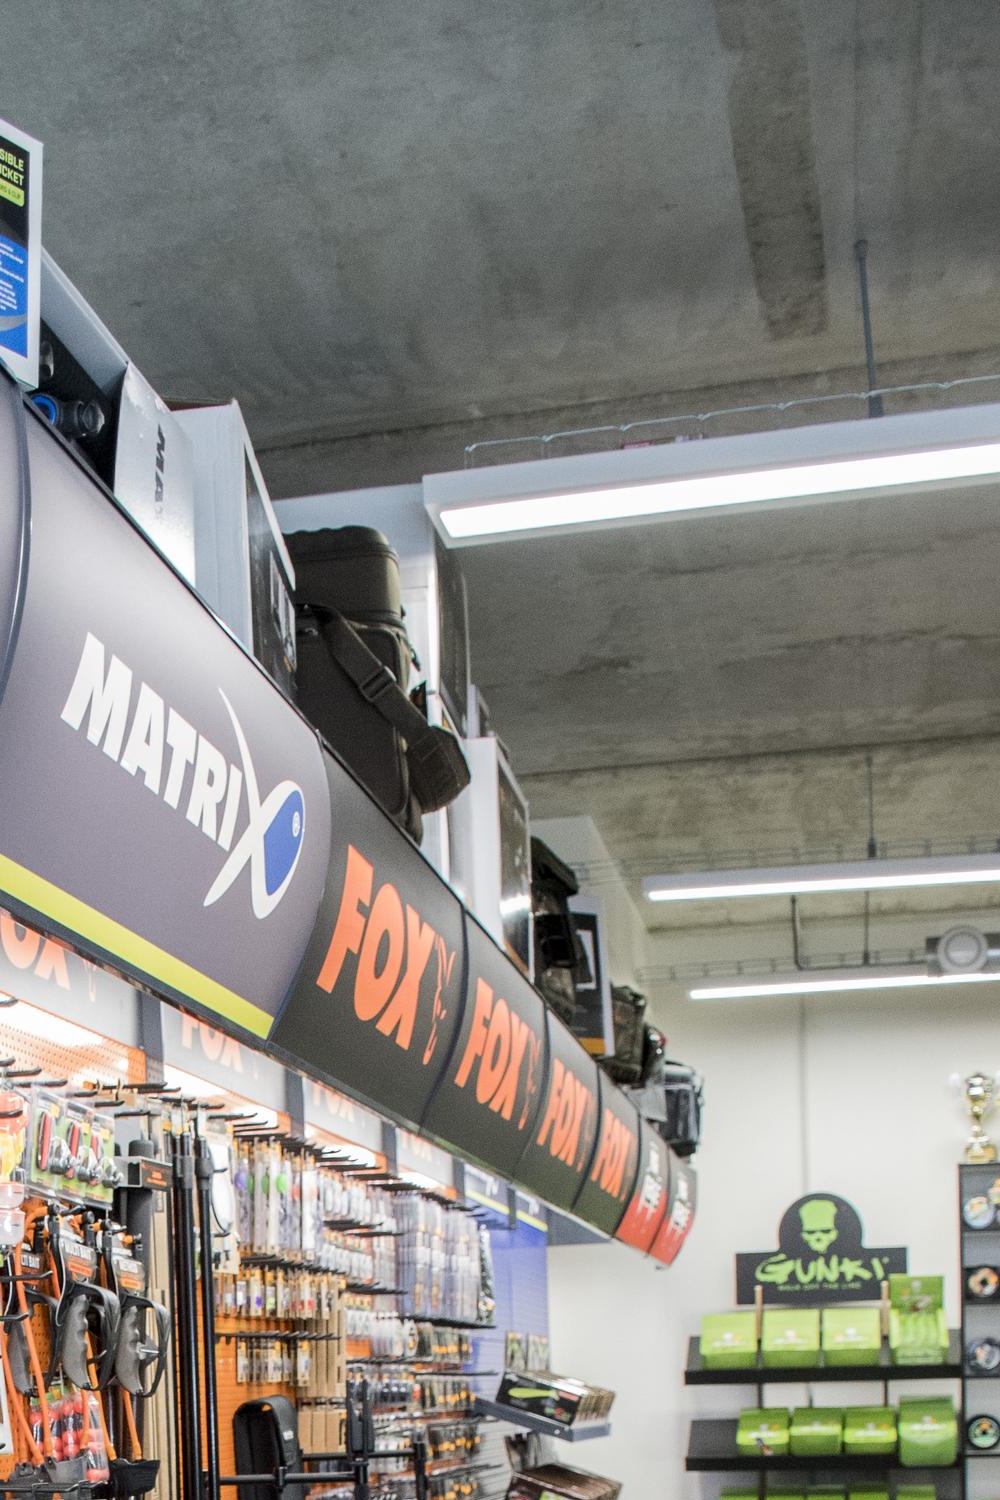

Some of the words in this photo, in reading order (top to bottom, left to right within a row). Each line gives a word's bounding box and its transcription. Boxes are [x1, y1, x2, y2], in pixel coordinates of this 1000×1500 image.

[60, 632, 305, 919] MATRIX
[316, 843, 437, 1051] FOX
[454, 978, 530, 1122] FOX
[536, 1058, 590, 1167] FOX
[590, 1108, 632, 1199] FOX
[755, 1252, 886, 1285] GUNKI
